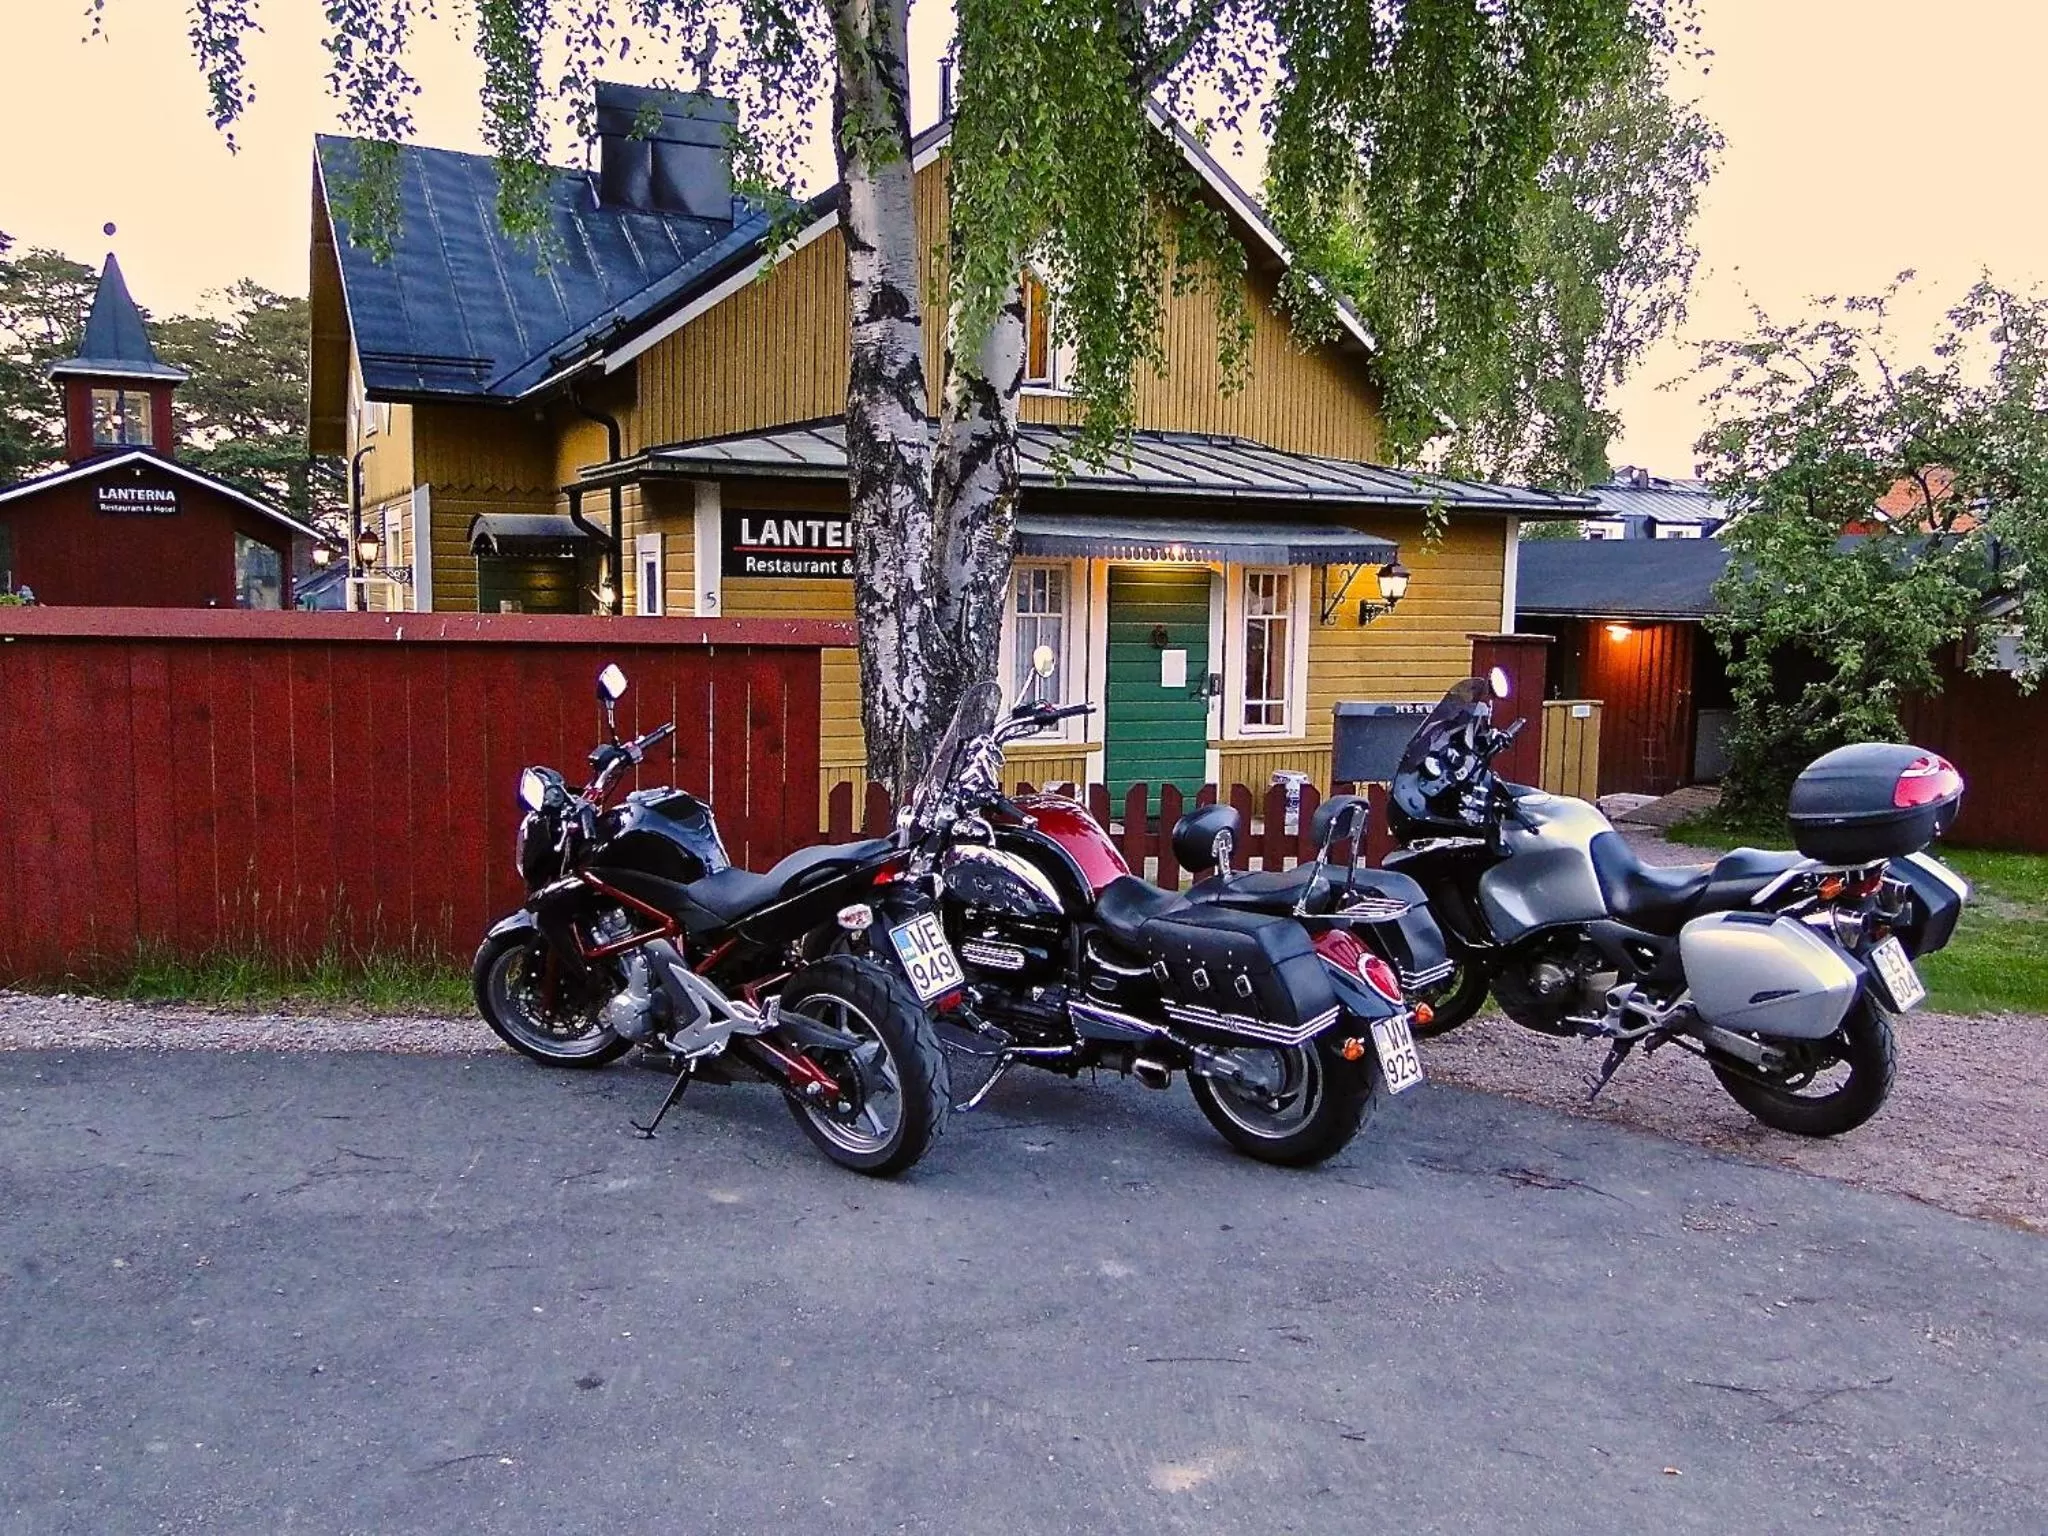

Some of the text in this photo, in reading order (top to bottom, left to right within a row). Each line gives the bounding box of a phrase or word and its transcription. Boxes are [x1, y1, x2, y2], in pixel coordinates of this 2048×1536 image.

[98, 487, 176, 501] LANTERNA
[100, 503, 144, 512] Restaurant
[153, 505, 176, 513] Hotel
[746, 556, 837, 574] Restaurant
[704, 591, 717, 609] 5
[1394, 704, 1434, 714] MENU
[908, 921, 943, 955] WE
[912, 951, 956, 990] 949
[1386, 1048, 1418, 1084] 925
